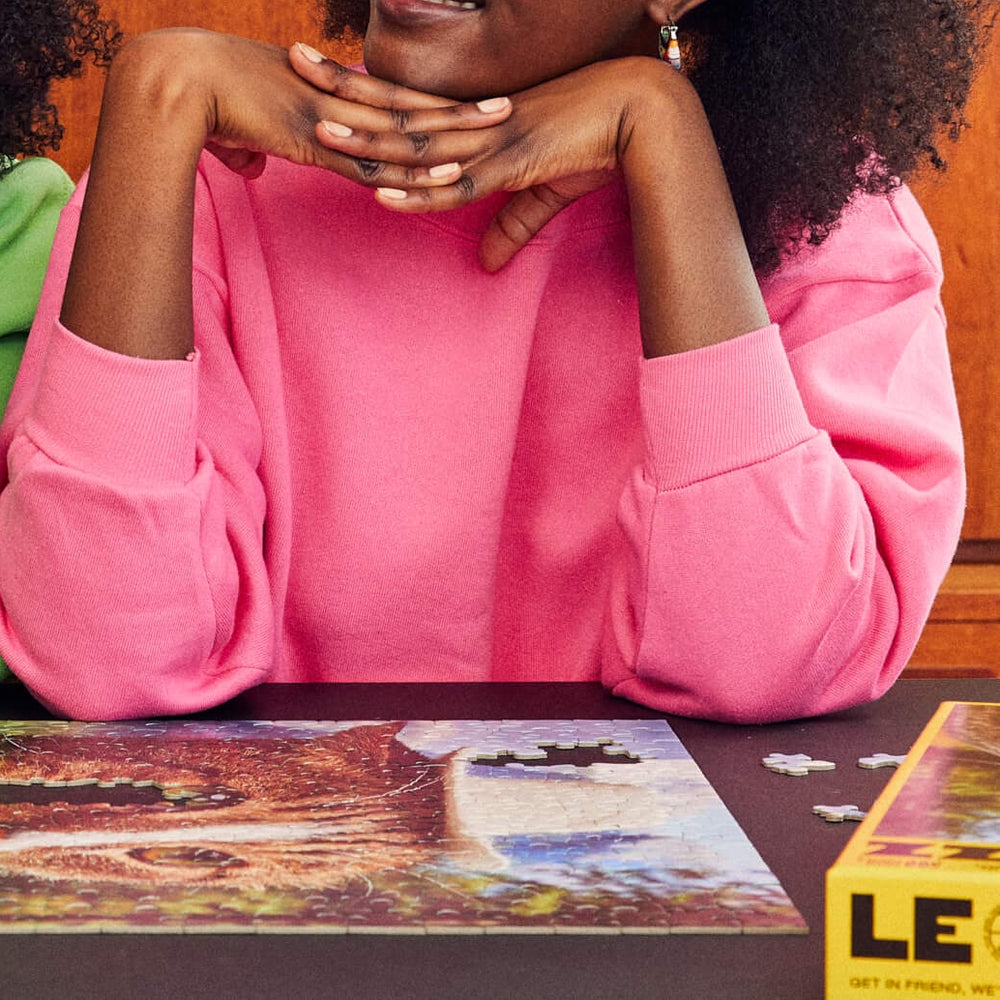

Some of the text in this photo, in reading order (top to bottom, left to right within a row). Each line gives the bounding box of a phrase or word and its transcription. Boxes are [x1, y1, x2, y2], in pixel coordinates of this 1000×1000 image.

[851, 893, 973, 964] LE
[848, 976, 881, 989] GET
[885, 979, 901, 990] IN
[904, 979, 966, 996] FRIEND,
